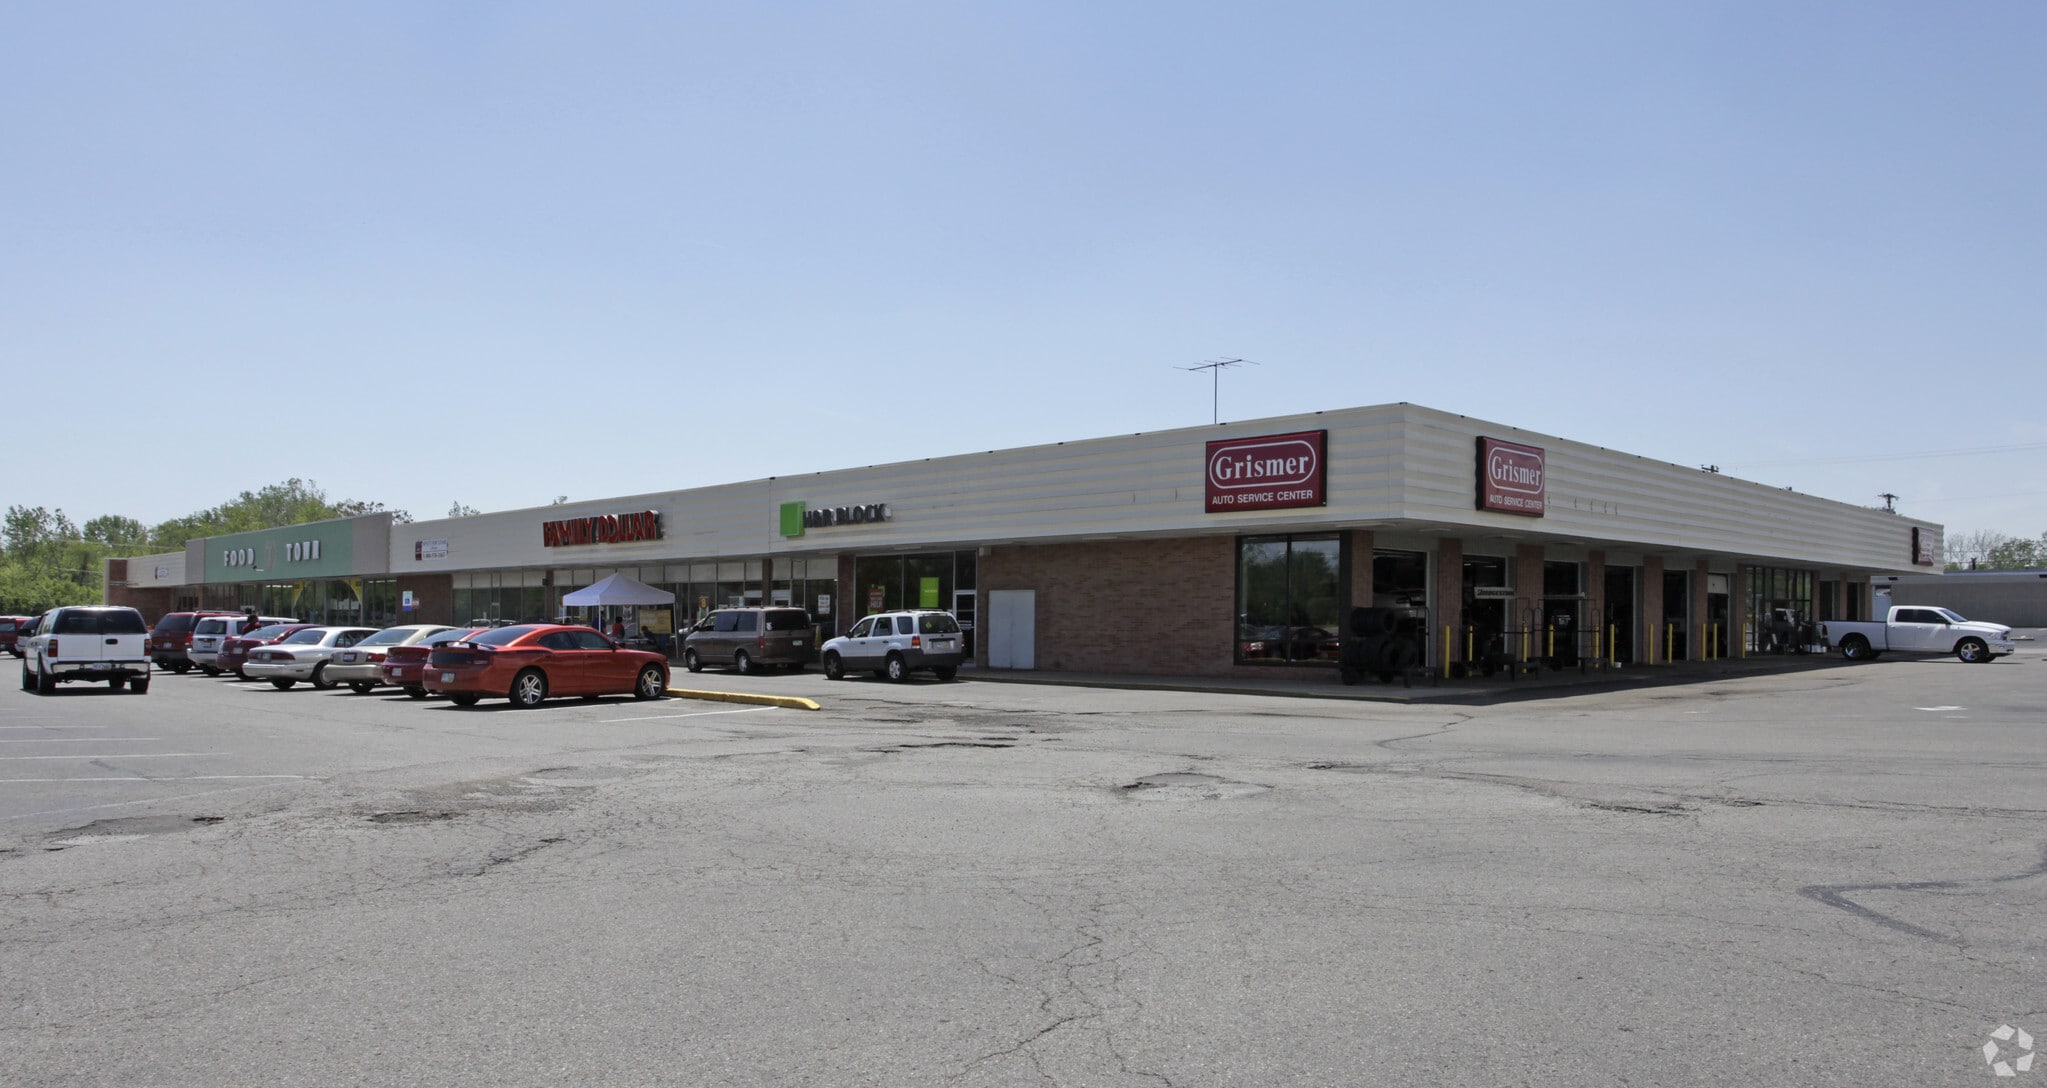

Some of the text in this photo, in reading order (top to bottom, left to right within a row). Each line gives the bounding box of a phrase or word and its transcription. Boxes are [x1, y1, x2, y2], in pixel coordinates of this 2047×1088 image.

[1215, 454, 1309, 480] Grismer
[1491, 456, 1541, 486] Grismer
[1212, 489, 1313, 505] AUTO SERVICE CENTER
[1489, 494, 1542, 510] AUTO SERVICE CENTER
[836, 504, 887, 526] BLOCK
[543, 510, 656, 547] FAMILY DOLLAR
[223, 540, 319, 567] FOOD TOWN
